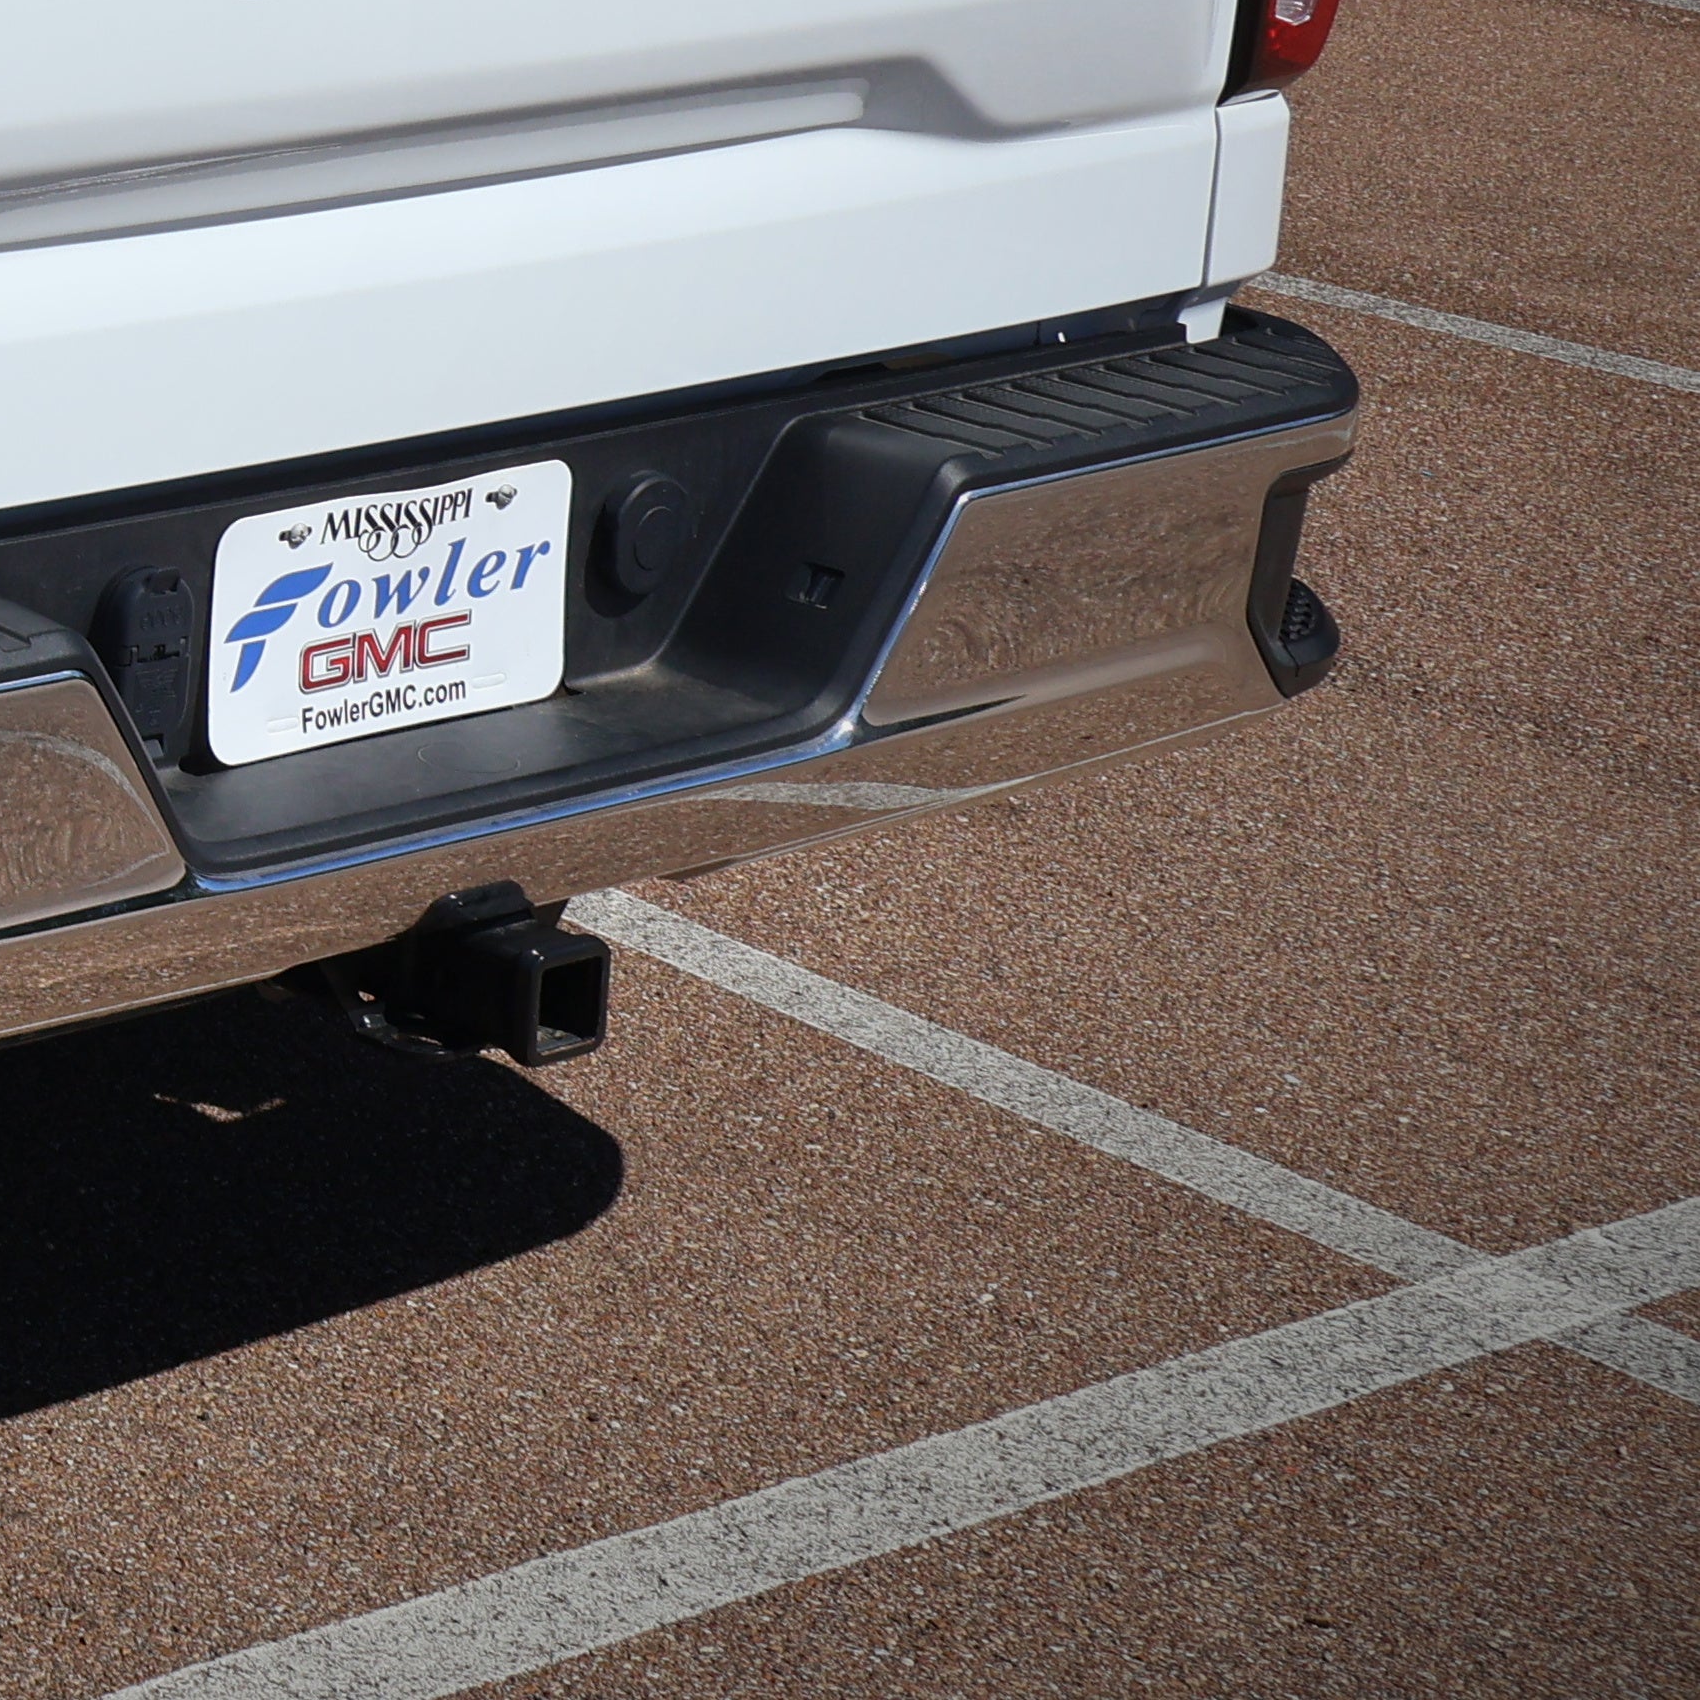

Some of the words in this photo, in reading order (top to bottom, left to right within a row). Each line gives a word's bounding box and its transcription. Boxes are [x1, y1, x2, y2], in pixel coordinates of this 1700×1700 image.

[320, 488, 474, 561] MISSISSIPPI
[223, 537, 551, 694] Fowler
[299, 609, 472, 695] GMC
[301, 678, 466, 733] FowlerGMC.com
